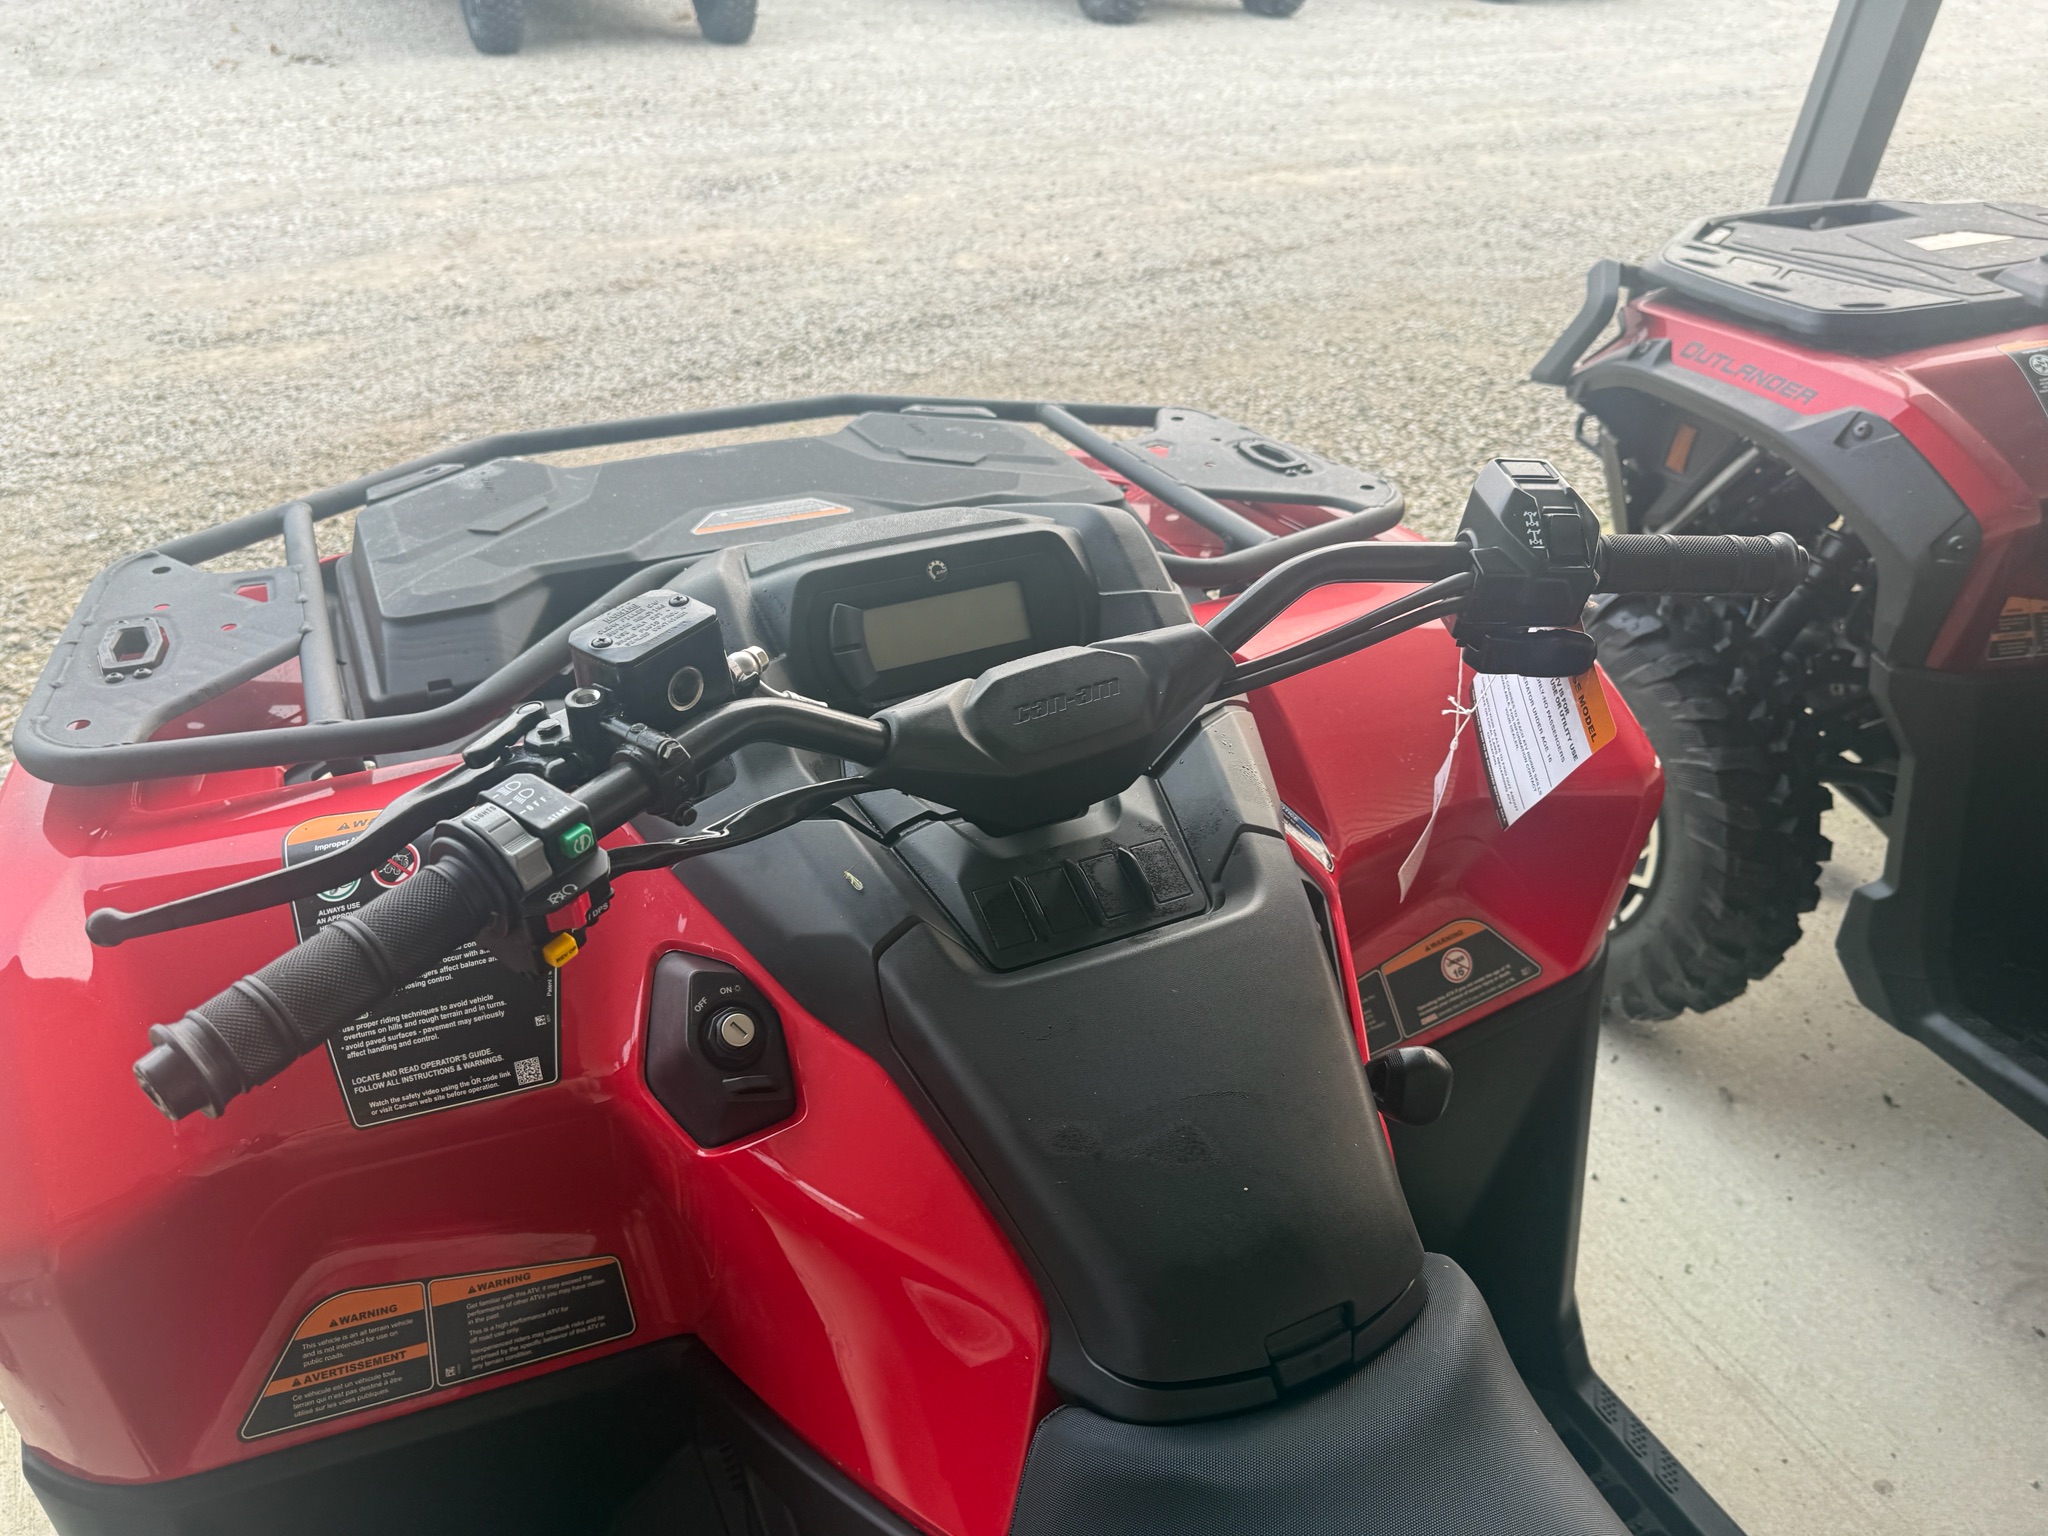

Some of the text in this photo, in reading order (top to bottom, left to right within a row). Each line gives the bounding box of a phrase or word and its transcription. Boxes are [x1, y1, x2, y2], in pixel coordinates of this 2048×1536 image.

[1679, 341, 1819, 405] OUTLANDER
[1523, 676, 1534, 706] ERATOR
[1532, 707, 1543, 734] UNDER
[1541, 736, 1549, 752] AGE
[1558, 686, 1571, 716] IS FOR
[1550, 679, 1579, 762] USE OR UTILITY USE
[1578, 694, 1597, 743] MODEL
[1546, 709, 1565, 762] PASSENGERS
[470, 804, 498, 822] LIGHTS
[547, 806, 571, 822] START
[314, 839, 350, 851] Improper
[318, 901, 360, 916] ALWAYS USE
[592, 902, 609, 918] DPS
[439, 964, 459, 973] affect
[459, 958, 486, 968] balance
[442, 954, 462, 962] occur
[463, 949, 478, 958] with
[427, 973, 453, 984] control.
[1453, 967, 1465, 978] 16
[694, 996, 708, 1012] OFF
[719, 986, 733, 995] ON
[342, 1025, 354, 1033] use
[355, 1020, 378, 1031] proper
[380, 1015, 400, 1024] riding
[401, 1007, 439, 1019] techniques
[449, 999, 468, 1009] avoid
[469, 994, 493, 1004] vehicle
[343, 1029, 376, 1041] overturns
[387, 1023, 403, 1031] hills
[404, 1019, 417, 1028] and
[418, 1015, 439, 1024] rough
[440, 1010, 463, 1019] terrain
[464, 1005, 477, 1014] and
[486, 1000, 506, 1009] turns.
[345, 1040, 364, 1050] avoid
[365, 1036, 386, 1047] paved
[387, 1030, 417, 1041] surfaces
[422, 1021, 456, 1035] pavement
[473, 1010, 504, 1022] seriously
[347, 1033, 439, 1059] affect handling and control.
[351, 1047, 493, 1085] LOCATE AND READ OPERATOR'S GUIDE.
[354, 1081, 385, 1094] FOLLOW
[386, 1078, 401, 1087] ALL
[401, 1065, 455, 1083] INSTRUCTIONS
[463, 1054, 504, 1069] WARNINGS.
[368, 1099, 389, 1108] Watch
[401, 1092, 420, 1101] safety
[421, 1088, 439, 1096] video
[440, 1084, 459, 1092] using
[470, 1077, 481, 1085] QR
[482, 1074, 498, 1082] code
[498, 1070, 511, 1078] link
[393, 1101, 418, 1110] Can-am
[446, 1090, 466, 1098] before
[468, 1082, 499, 1093] operation.
[476, 1271, 532, 1293] WARNING
[338, 1304, 399, 1327] WARNING
[467, 1304, 505, 1318] performance
[495, 1321, 508, 1329] high
[509, 1312, 546, 1326] performance
[547, 1307, 559, 1315] ATV
[302, 1342, 316, 1350] This
[317, 1336, 341, 1346] vehicle
[368, 1324, 389, 1334] terrain
[390, 1319, 413, 1328] vehicle
[302, 1350, 315, 1358] and
[323, 1345, 335, 1353] not
[336, 1338, 364, 1349] intended
[303, 1352, 345, 1367] public roads.
[303, 1351, 407, 1385] AVERTISSEMENT
[292, 1400, 314, 1409] terrain
[327, 1391, 344, 1400] n'est
[358, 1381, 382, 1392] destiné
[389, 1376, 402, 1384] être
[303, 1387, 331, 1398] véhicule
[332, 1383, 343, 1391] est
[354, 1374, 381, 1385] véhicule
[382, 1369, 395, 1377] tout
[293, 1408, 313, 1417] utilisé
[314, 1404, 326, 1412] sur
[338, 1397, 356, 1405] voies
[357, 1388, 388, 1401] publiques
